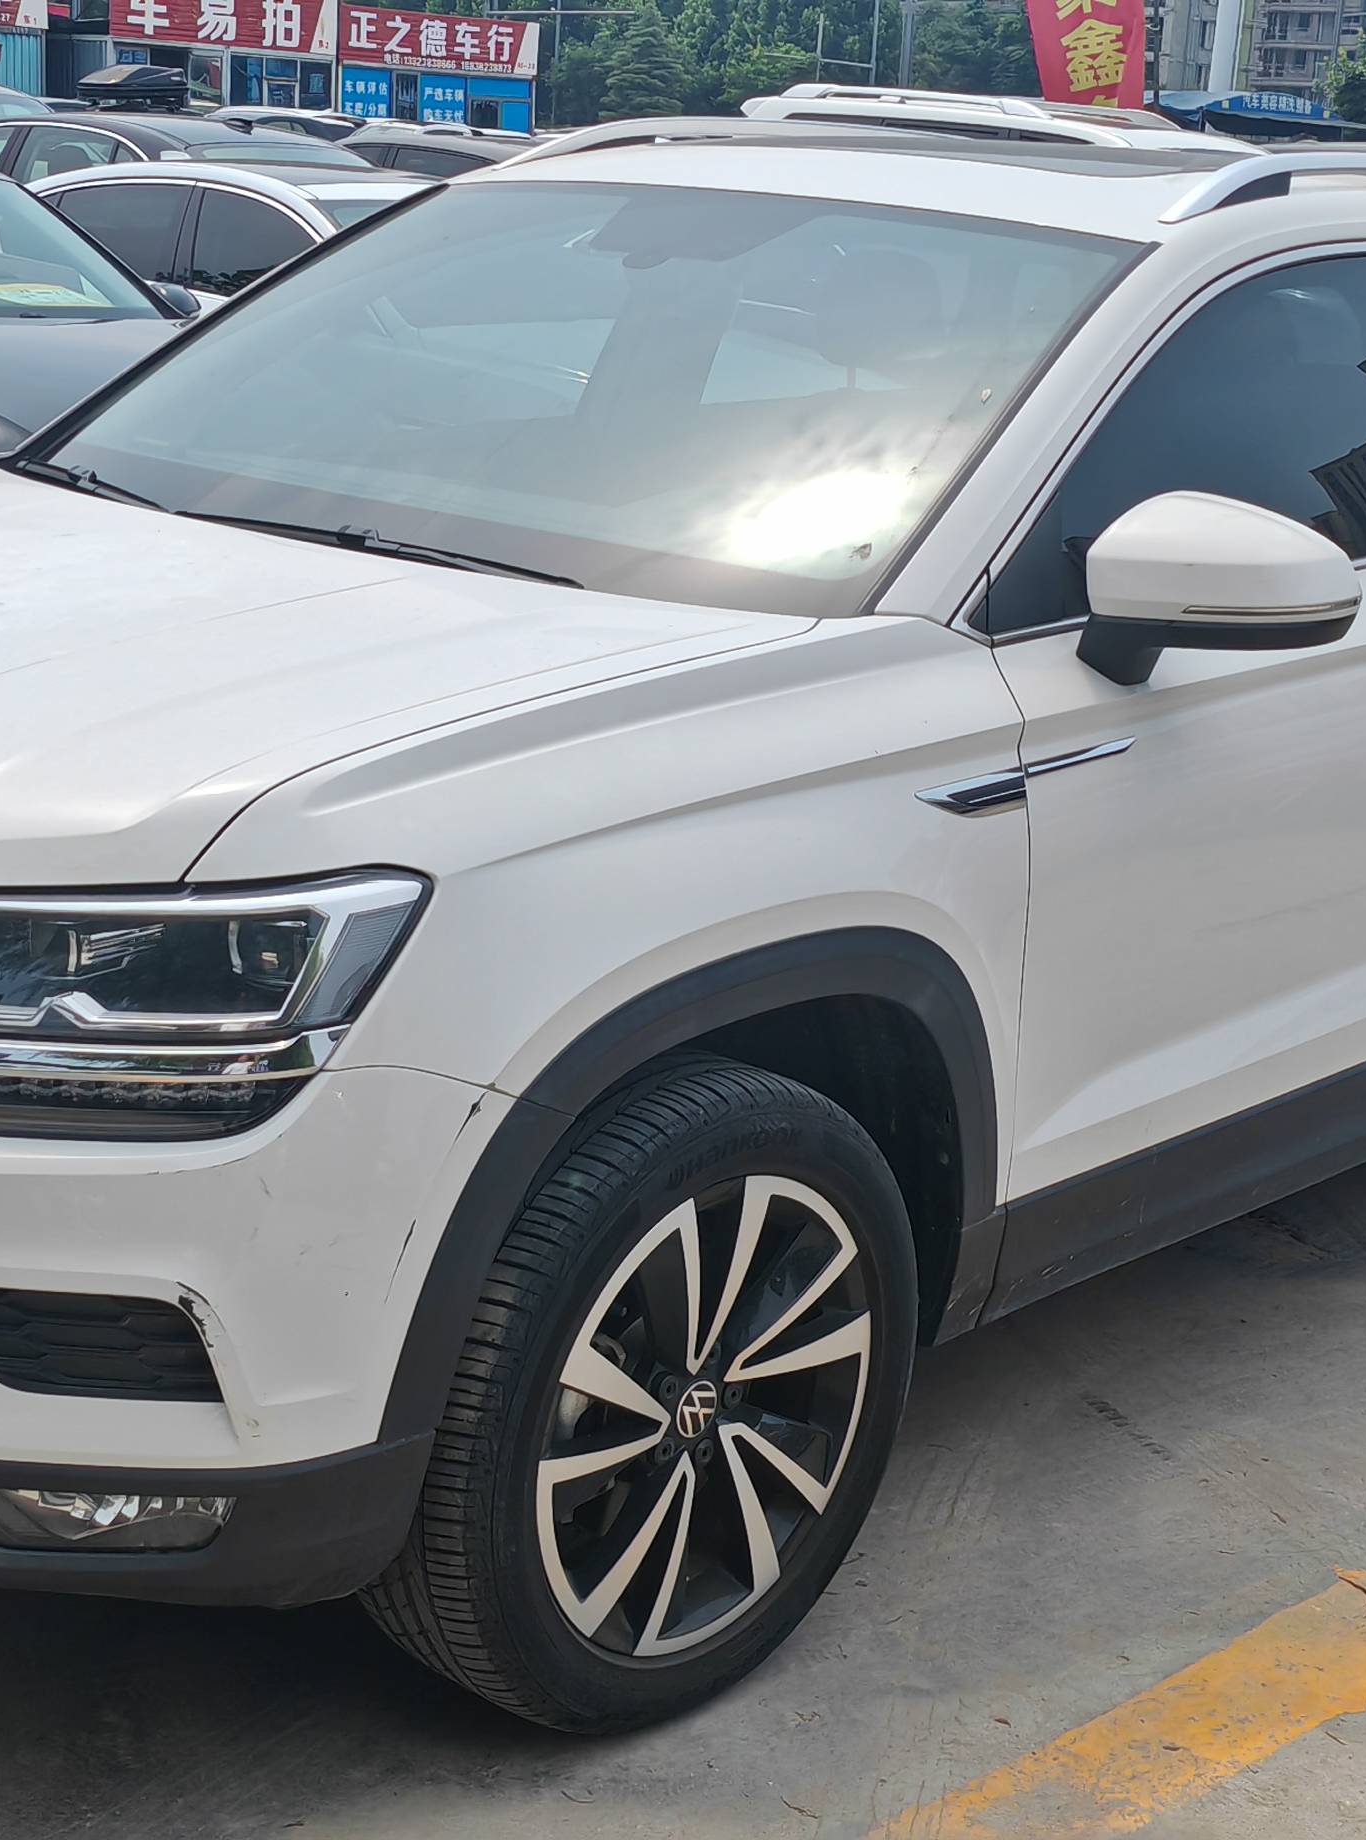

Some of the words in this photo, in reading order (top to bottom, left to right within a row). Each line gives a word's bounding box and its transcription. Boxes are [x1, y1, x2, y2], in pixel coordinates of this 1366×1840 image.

[348, 10, 514, 62] 正之德车行
[344, 80, 388, 96] 车辆评估
